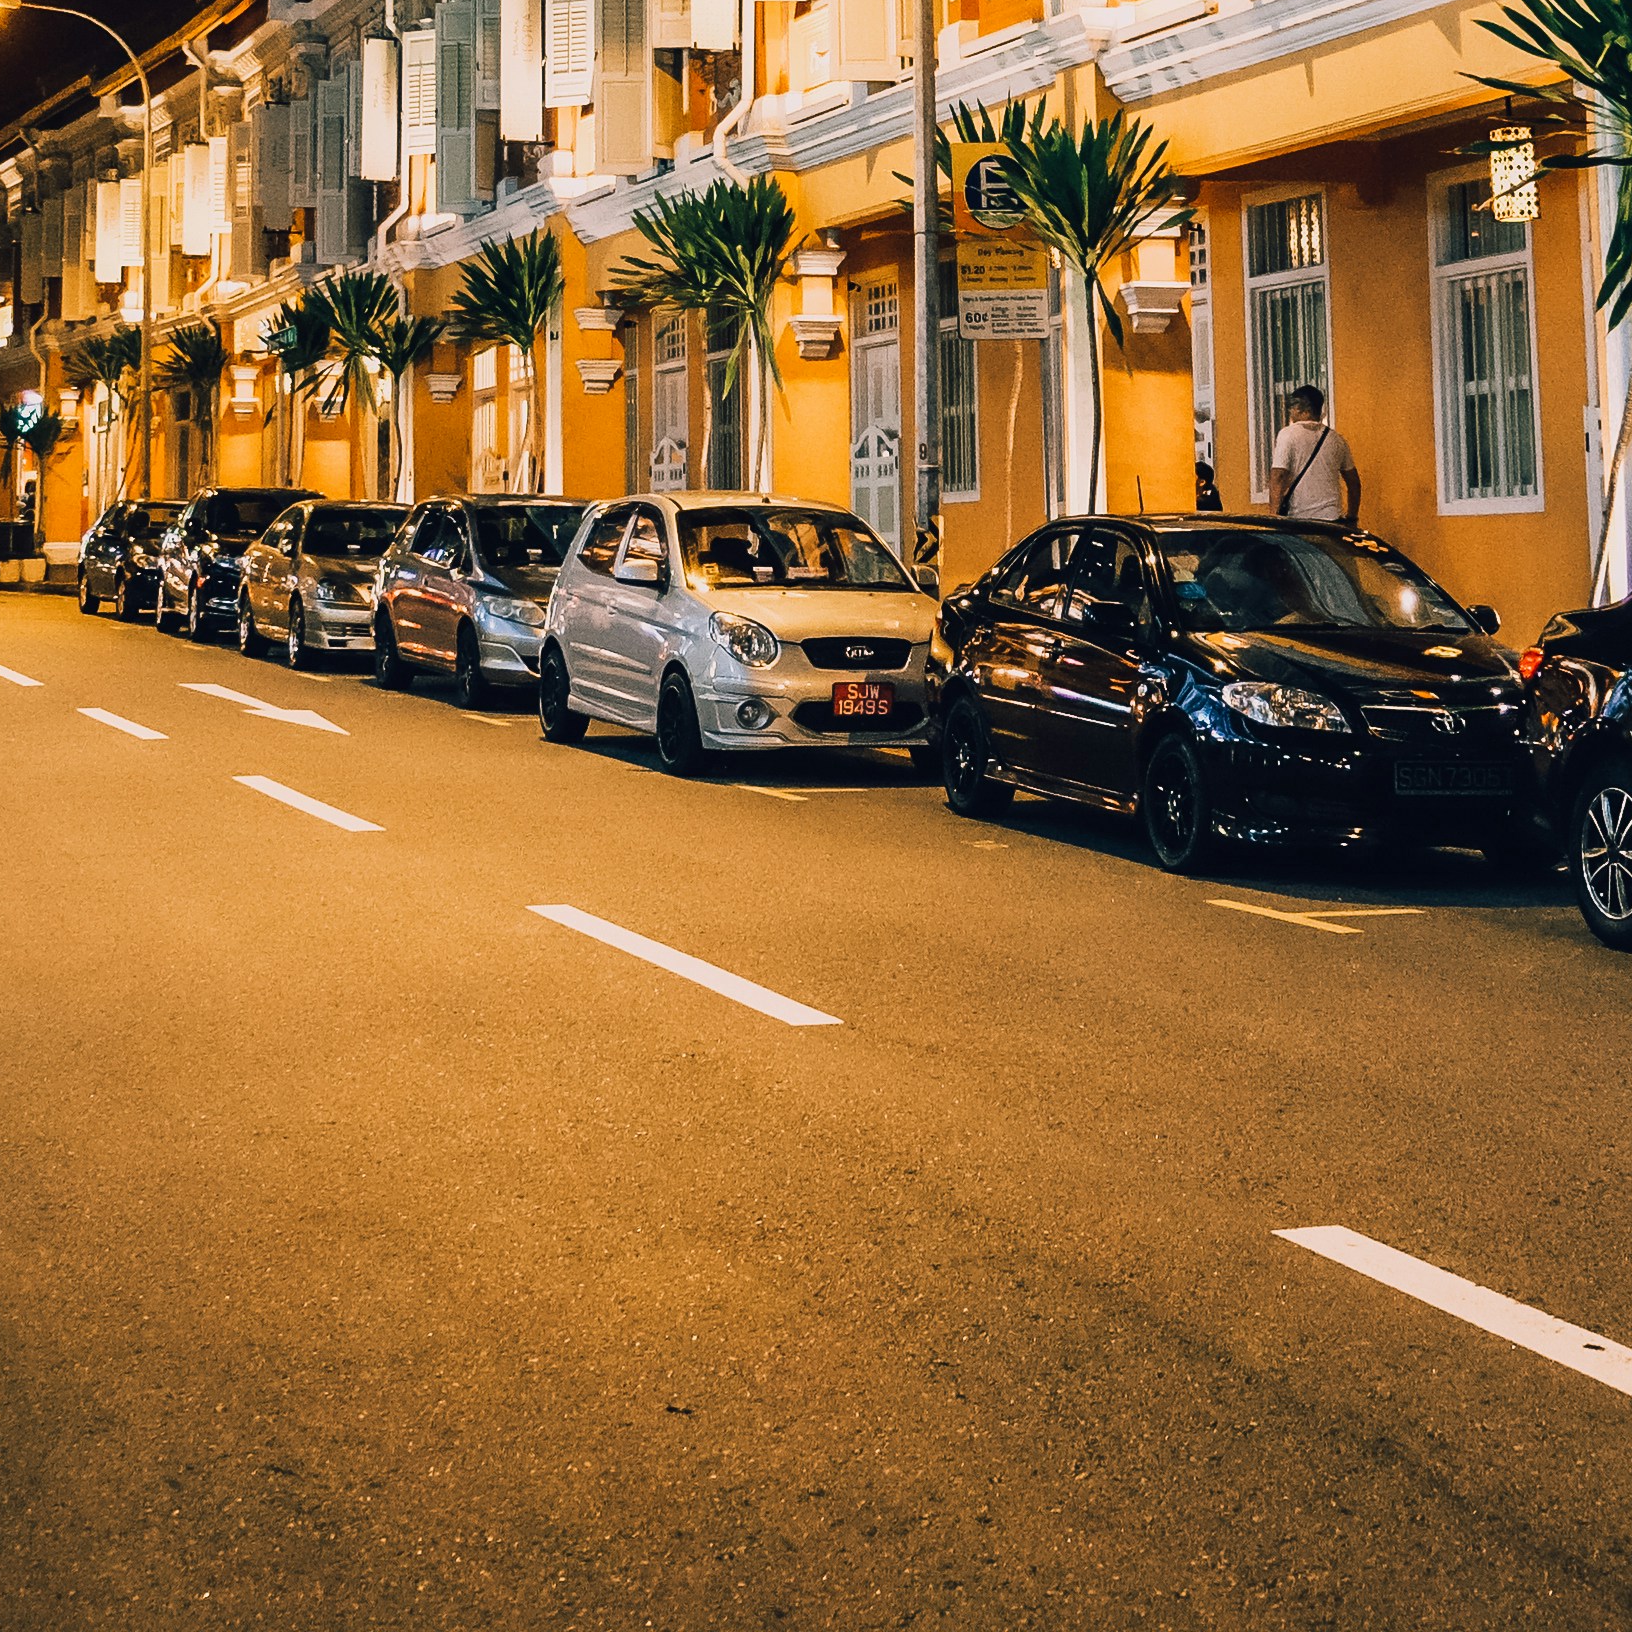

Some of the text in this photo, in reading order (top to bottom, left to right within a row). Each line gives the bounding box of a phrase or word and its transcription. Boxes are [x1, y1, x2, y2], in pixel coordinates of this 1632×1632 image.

[965, 311, 989, 324] 60¢
[848, 683, 880, 700] SJW
[838, 699, 888, 715] 1949S
